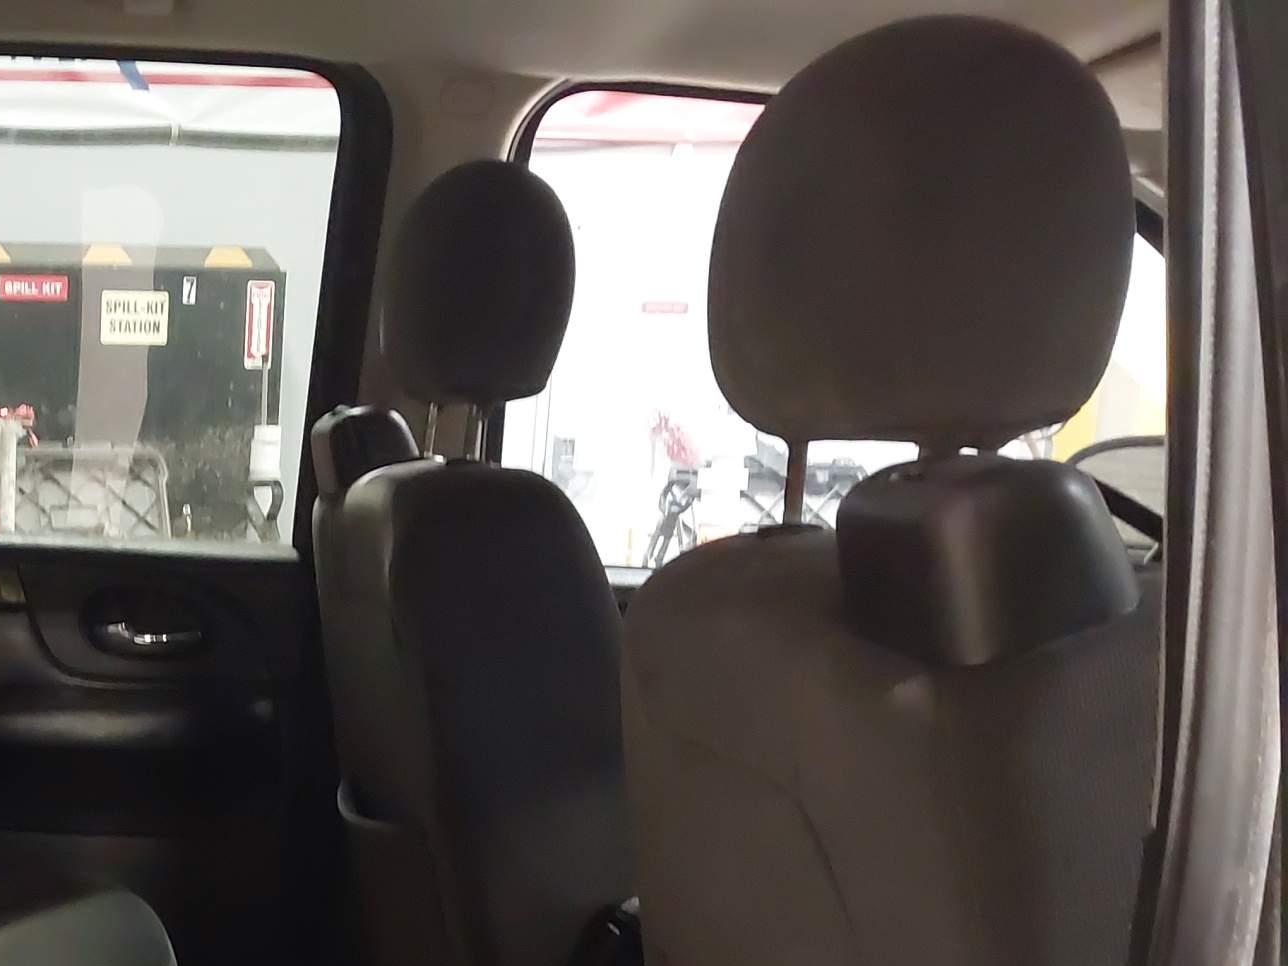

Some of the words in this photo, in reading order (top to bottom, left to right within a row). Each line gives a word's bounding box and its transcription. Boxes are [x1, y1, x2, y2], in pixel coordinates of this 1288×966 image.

[4, 281, 38, 295] SPILL
[42, 281, 62, 295] KIT
[185, 278, 195, 303] 7
[106, 300, 166, 315] SPILL-KIT
[109, 319, 161, 334] STATION
